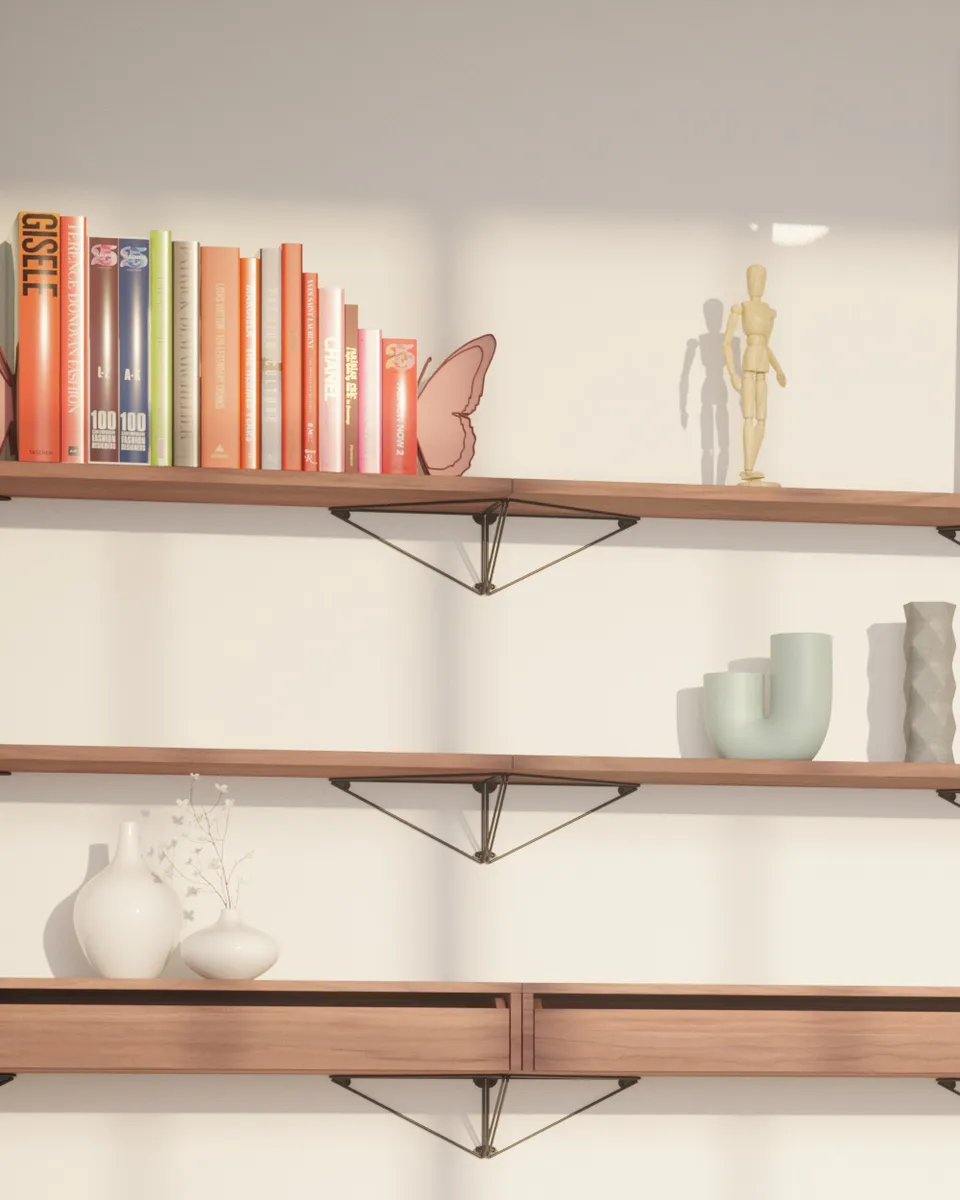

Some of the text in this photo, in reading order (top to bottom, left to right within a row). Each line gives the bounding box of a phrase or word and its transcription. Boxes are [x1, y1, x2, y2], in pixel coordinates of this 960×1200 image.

[22, 213, 58, 297] GISELE
[67, 223, 79, 414] TERENCE DONOVAN FASHION
[180, 246, 191, 440] PATRICK DEMARCHELIER
[265, 360, 277, 423] CULTURE
[324, 336, 337, 402] CHANEL
[91, 410, 116, 430] 100
[120, 412, 146, 431] 100
[396, 424, 404, 448] NOW
[396, 448, 404, 456] 2
